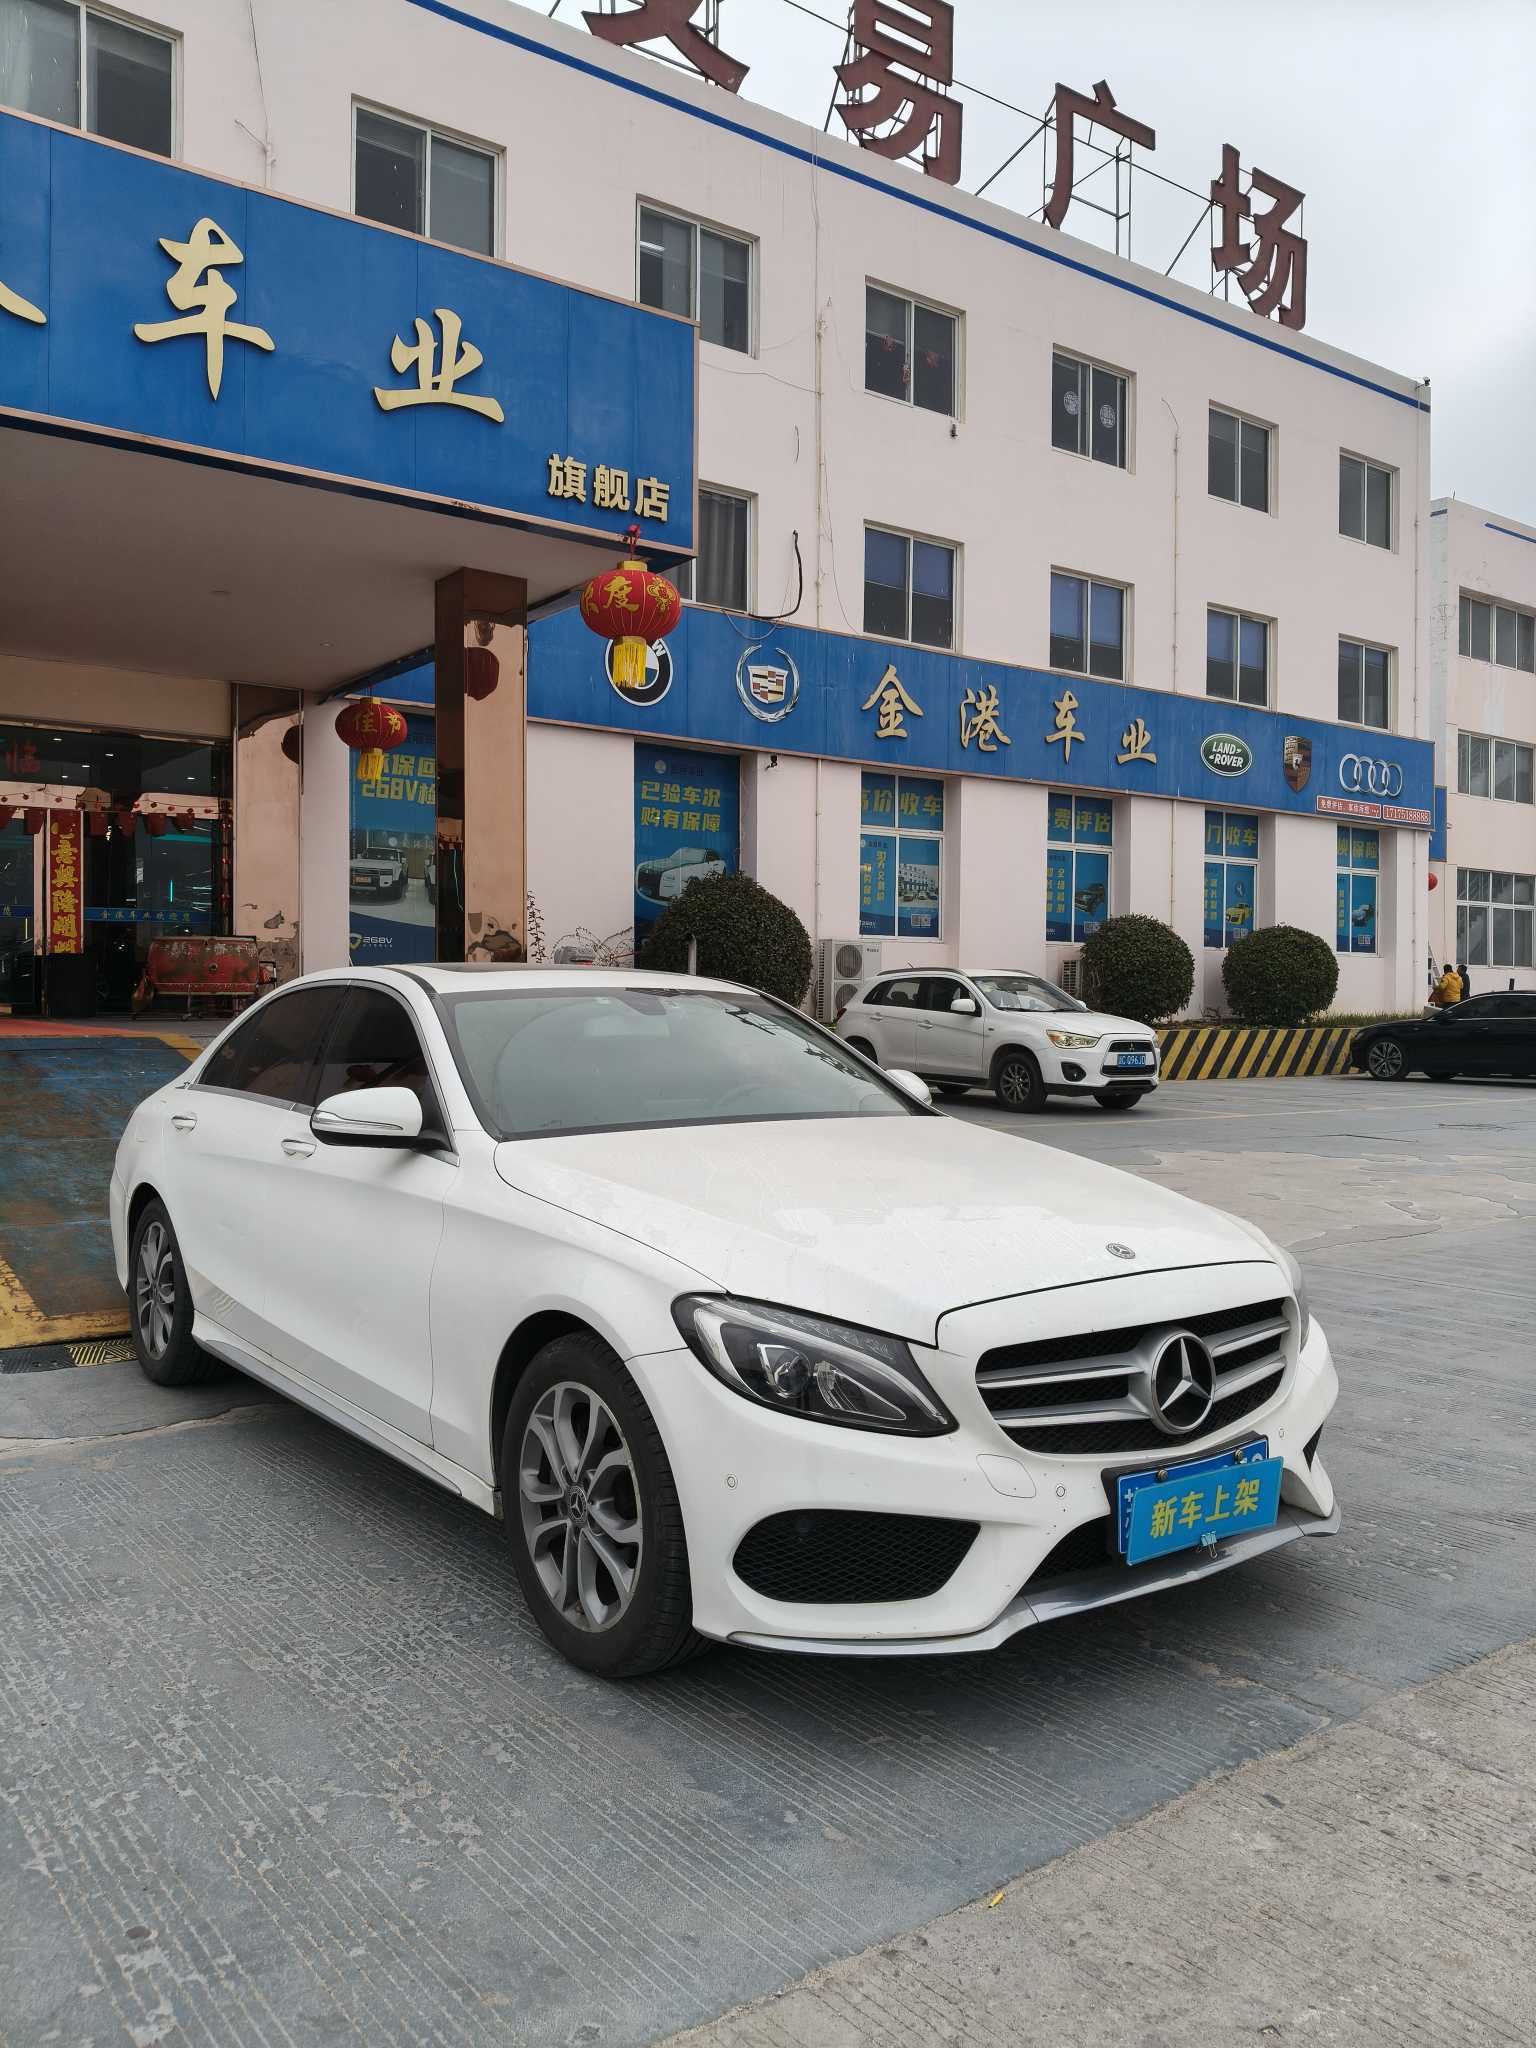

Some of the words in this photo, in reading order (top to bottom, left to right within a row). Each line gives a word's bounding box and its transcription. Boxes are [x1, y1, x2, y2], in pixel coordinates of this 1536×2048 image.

[0, 217, 505, 424] 车业
[547, 453, 671, 522] 旗舰店
[861, 664, 1158, 765] 金港车业
[1211, 741, 1236, 755] LAND
[1213, 753, 1244, 769] ROVER
[1047, 807, 1111, 833] 费评估
[1150, 1478, 1260, 1538] 新车上架
